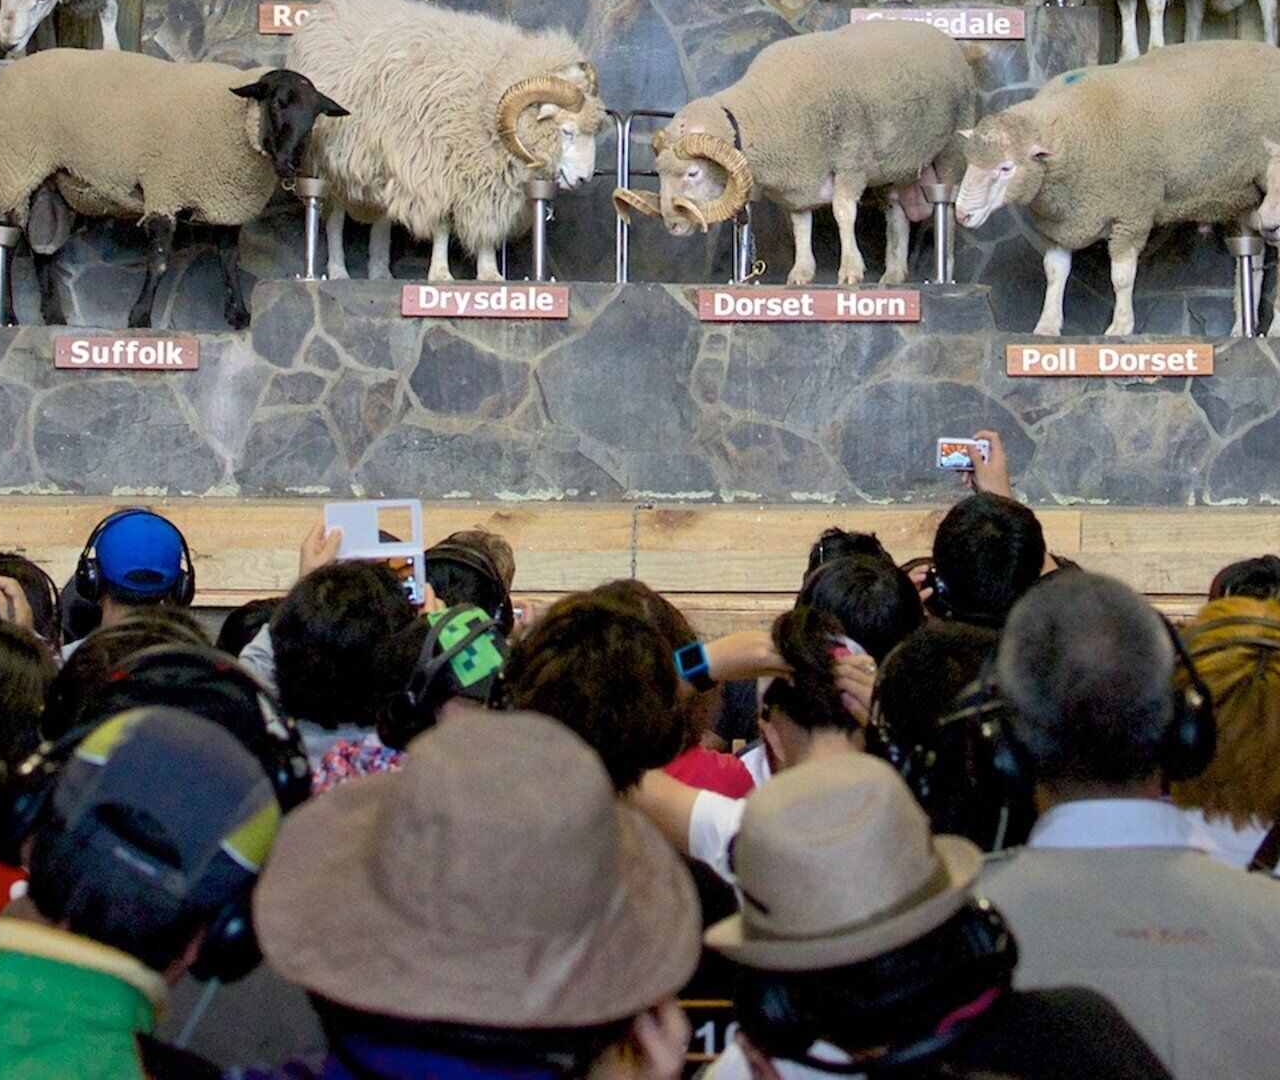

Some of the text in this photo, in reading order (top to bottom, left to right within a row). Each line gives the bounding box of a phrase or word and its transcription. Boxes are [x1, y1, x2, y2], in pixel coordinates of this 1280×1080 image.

[419, 285, 554, 316] Drysdale
[714, 292, 906, 317] Dorset Horn
[70, 340, 184, 365] Suffolk
[1022, 347, 1199, 372] Poll Dorset
